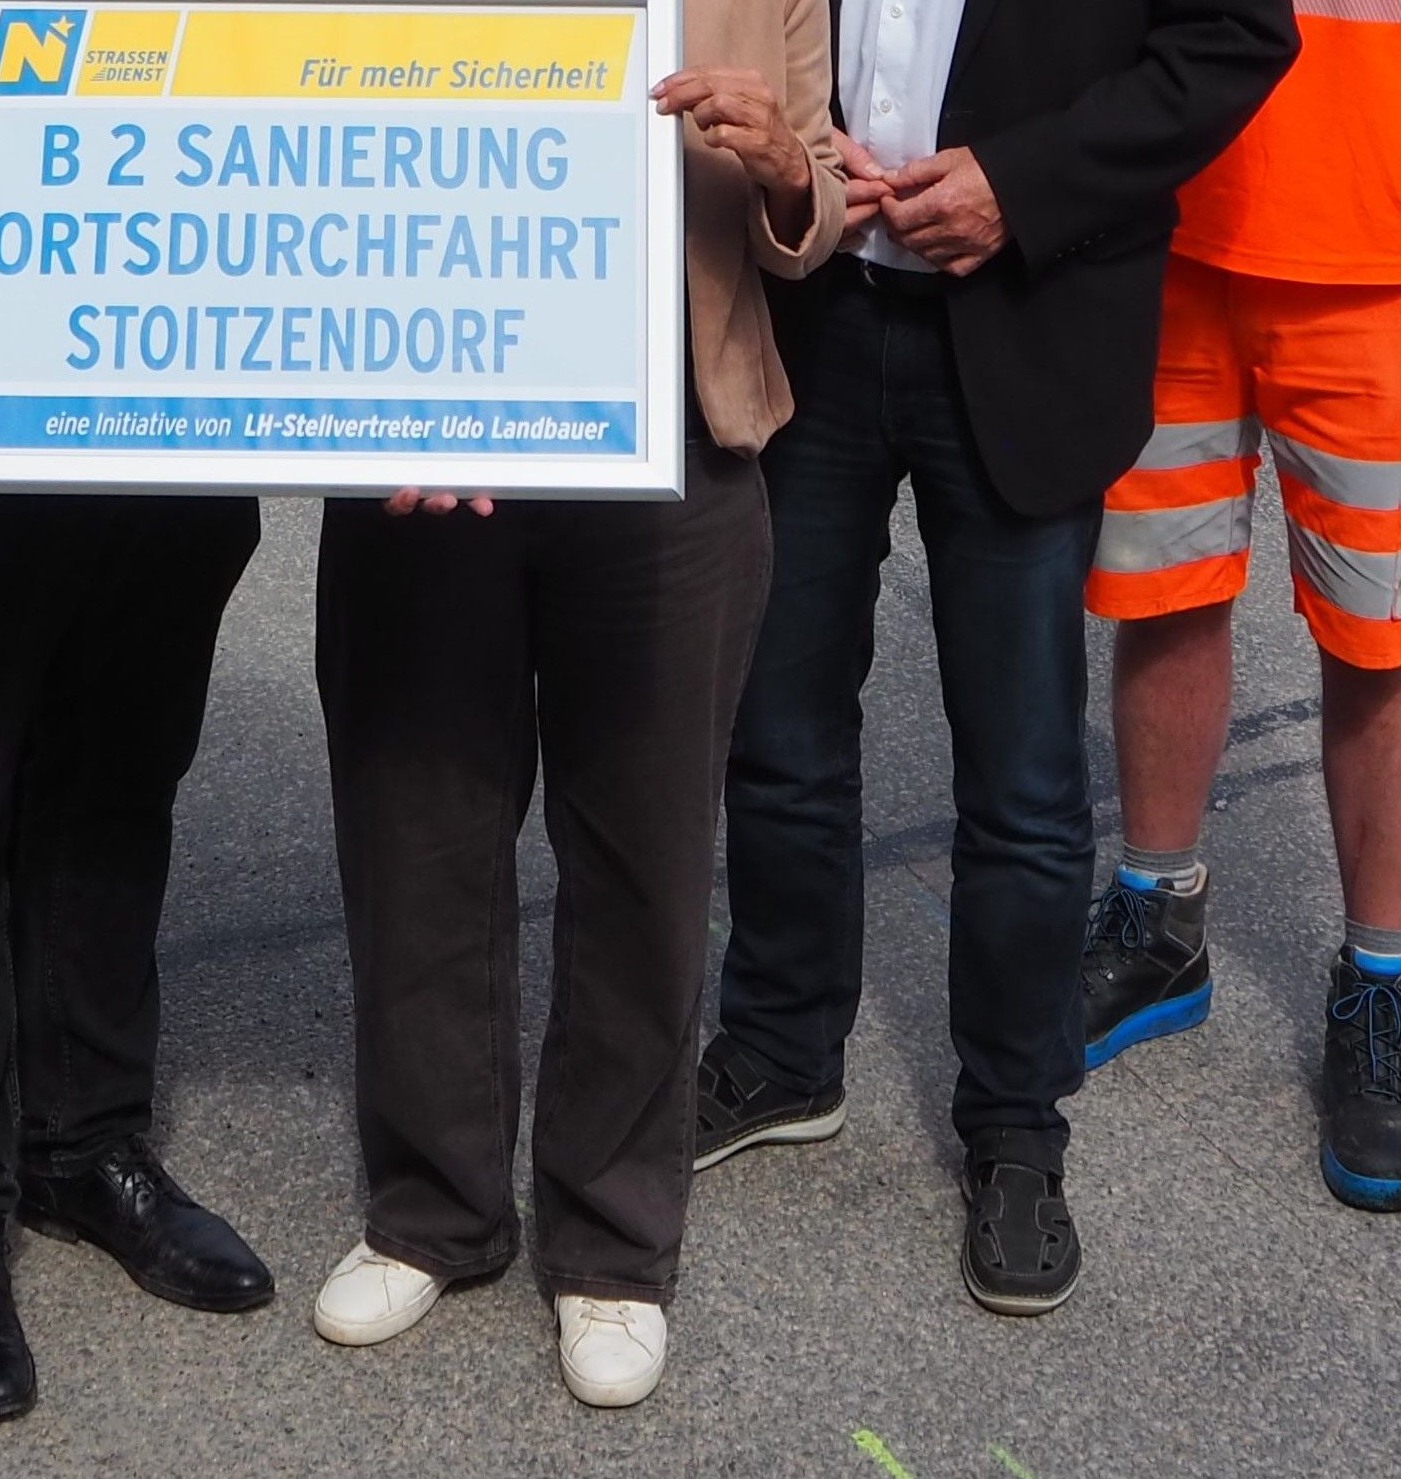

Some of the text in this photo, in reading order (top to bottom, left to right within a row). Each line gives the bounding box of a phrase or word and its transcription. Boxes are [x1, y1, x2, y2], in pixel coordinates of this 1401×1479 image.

[85, 50, 168, 65] STRASSEN
[105, 67, 165, 82] DIENST
[299, 58, 608, 90] Für mehr Sicherheit
[41, 123, 570, 191] B 2 SANIERUNG
[65, 304, 526, 374] STOITZENDORF
[45, 411, 610, 440] eine Initiative von LH-Stellvertreter Udo Landbauer
